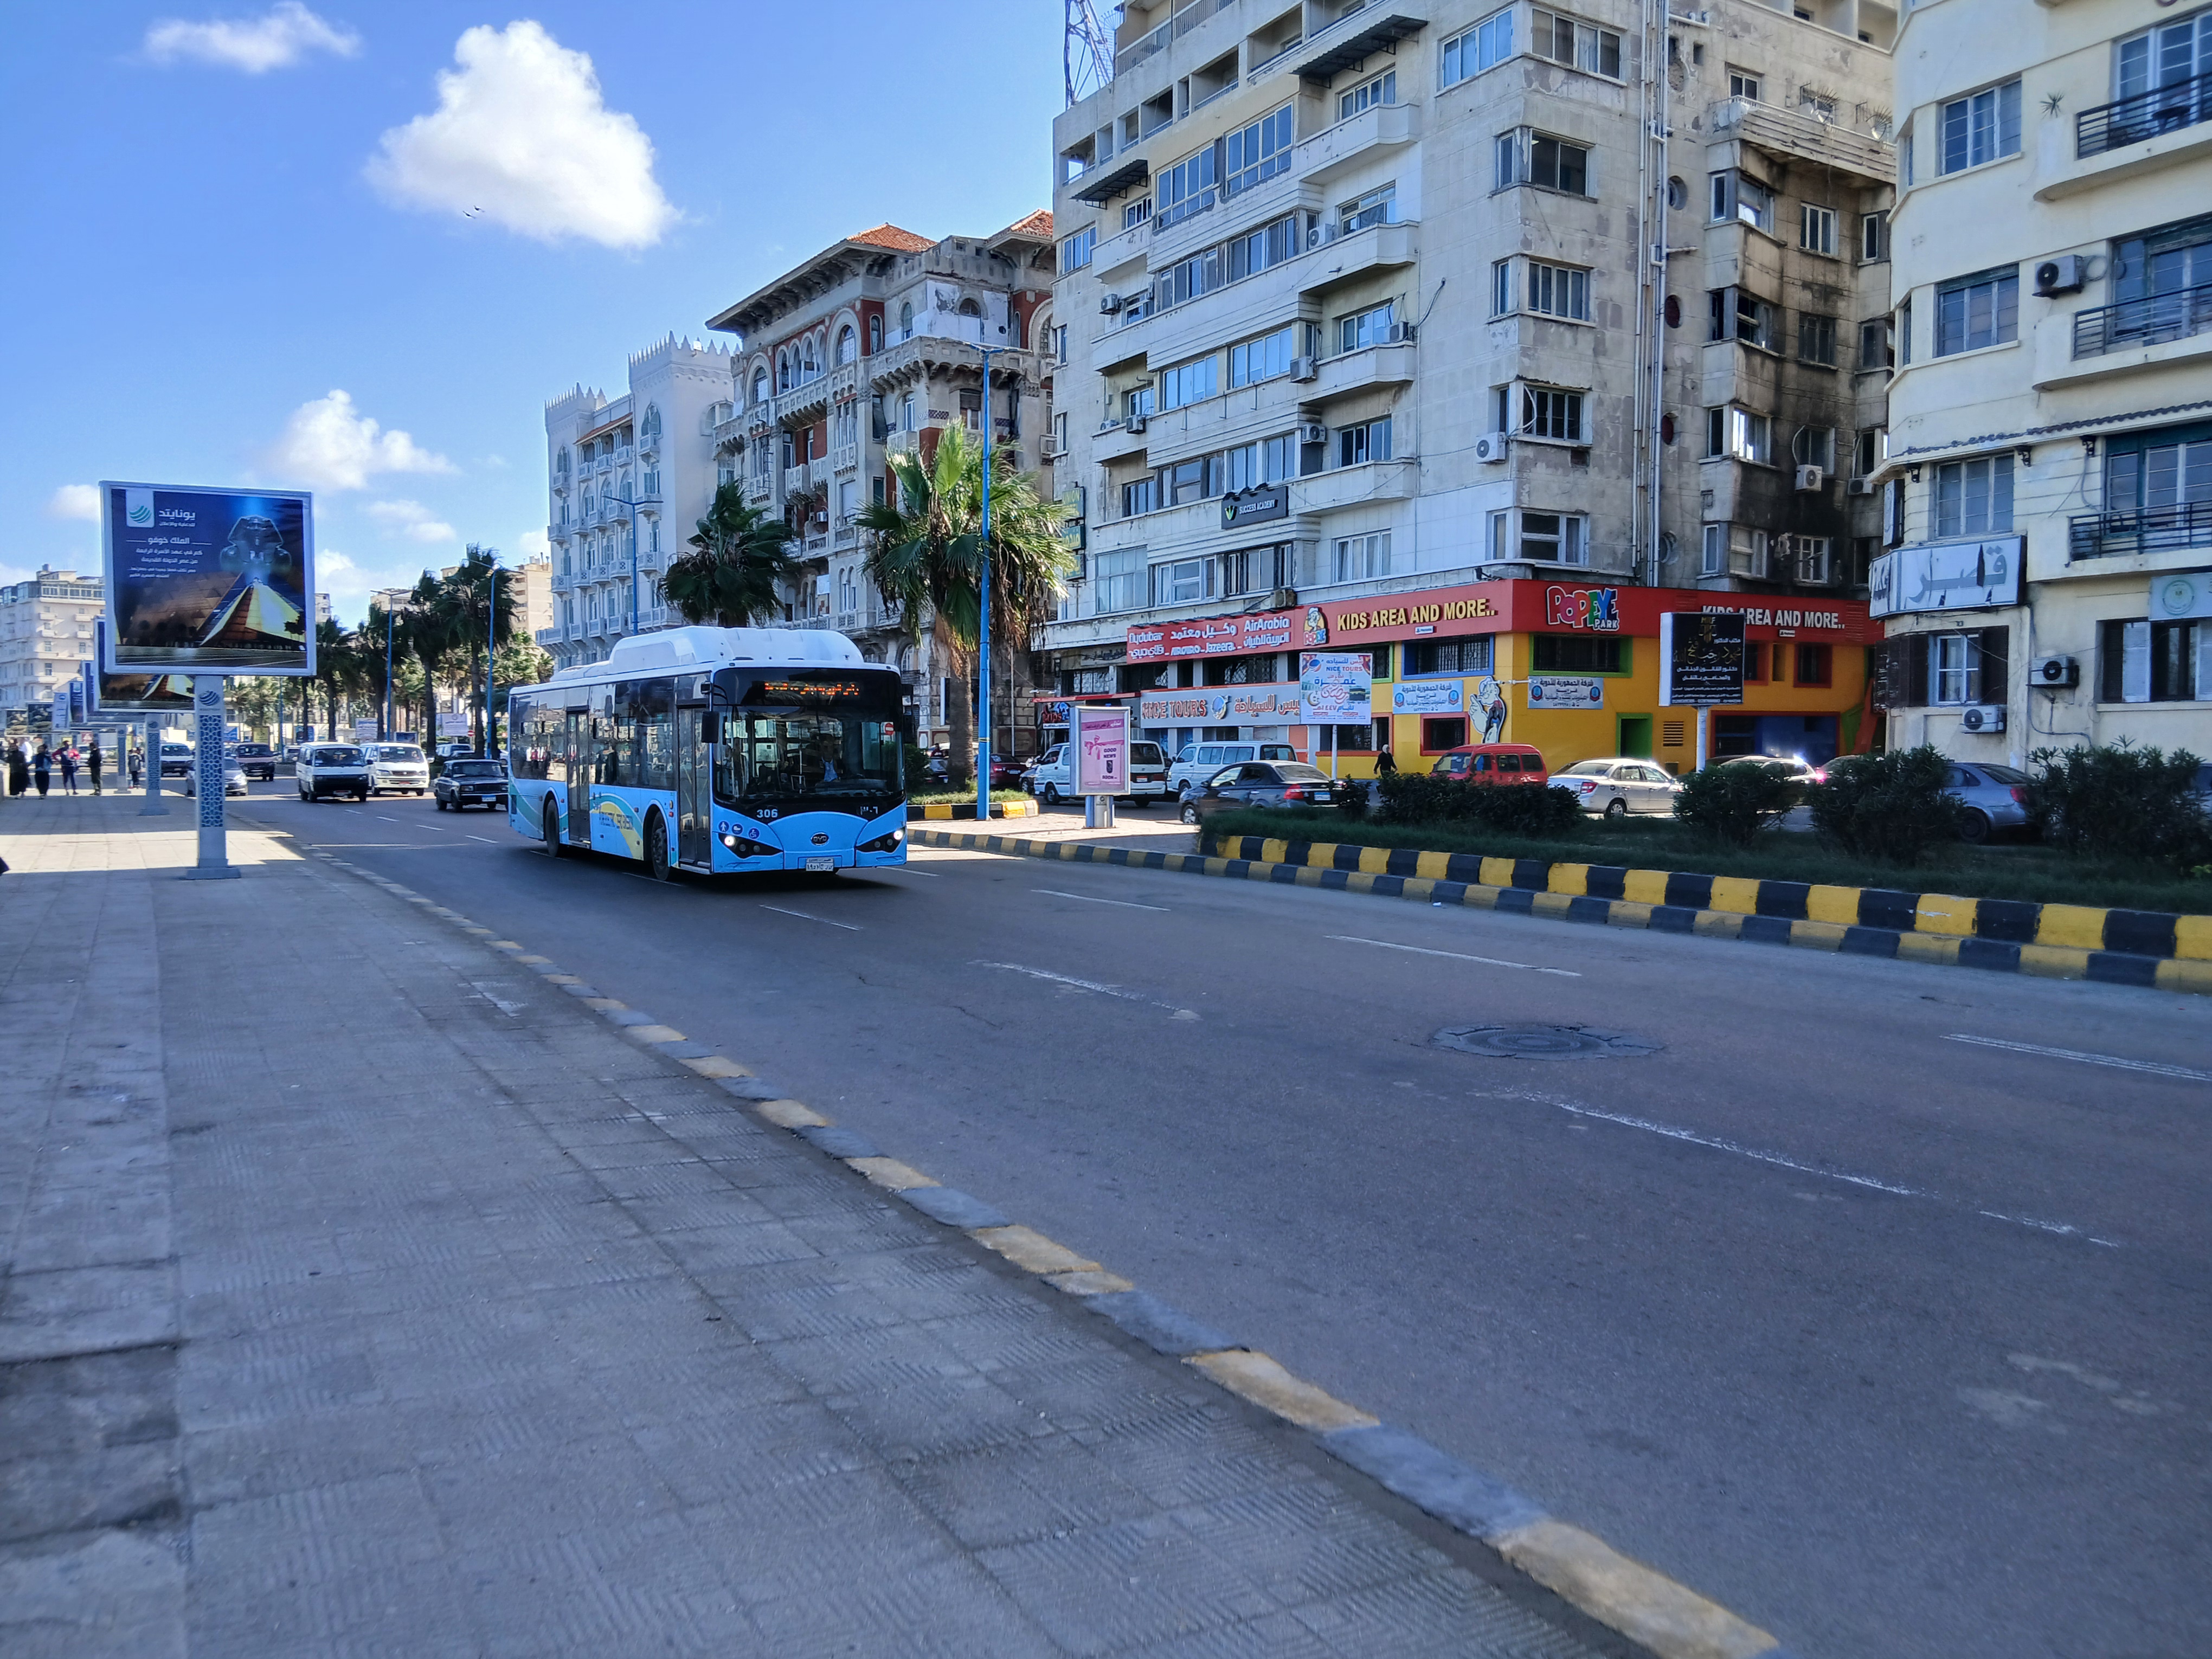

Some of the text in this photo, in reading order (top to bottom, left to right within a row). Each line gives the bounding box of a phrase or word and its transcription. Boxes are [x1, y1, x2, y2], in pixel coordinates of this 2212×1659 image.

[1239, 499, 1275, 514] SUCCESS ACADEMY
[159, 509, 196, 521] يونايتد
[148, 536, 169, 545] خوفو
[1547, 586, 1619, 628] POPEYE
[1244, 616, 1290, 632] AirArabia
[1338, 612, 1367, 632] KIDS
[1371, 608, 1407, 628] AREA
[1410, 605, 1437, 624] AND
[1594, 619, 1618, 629] PARK
[1774, 610, 1801, 627] AND
[1170, 622, 1237, 640] وكيل معتمد
[1142, 699, 1206, 719] NICE TOURS
[1234, 694, 1300, 717] يس للسياحة
[756, 809, 778, 818] 306
[860, 806, 878, 815] ٣٠٦
